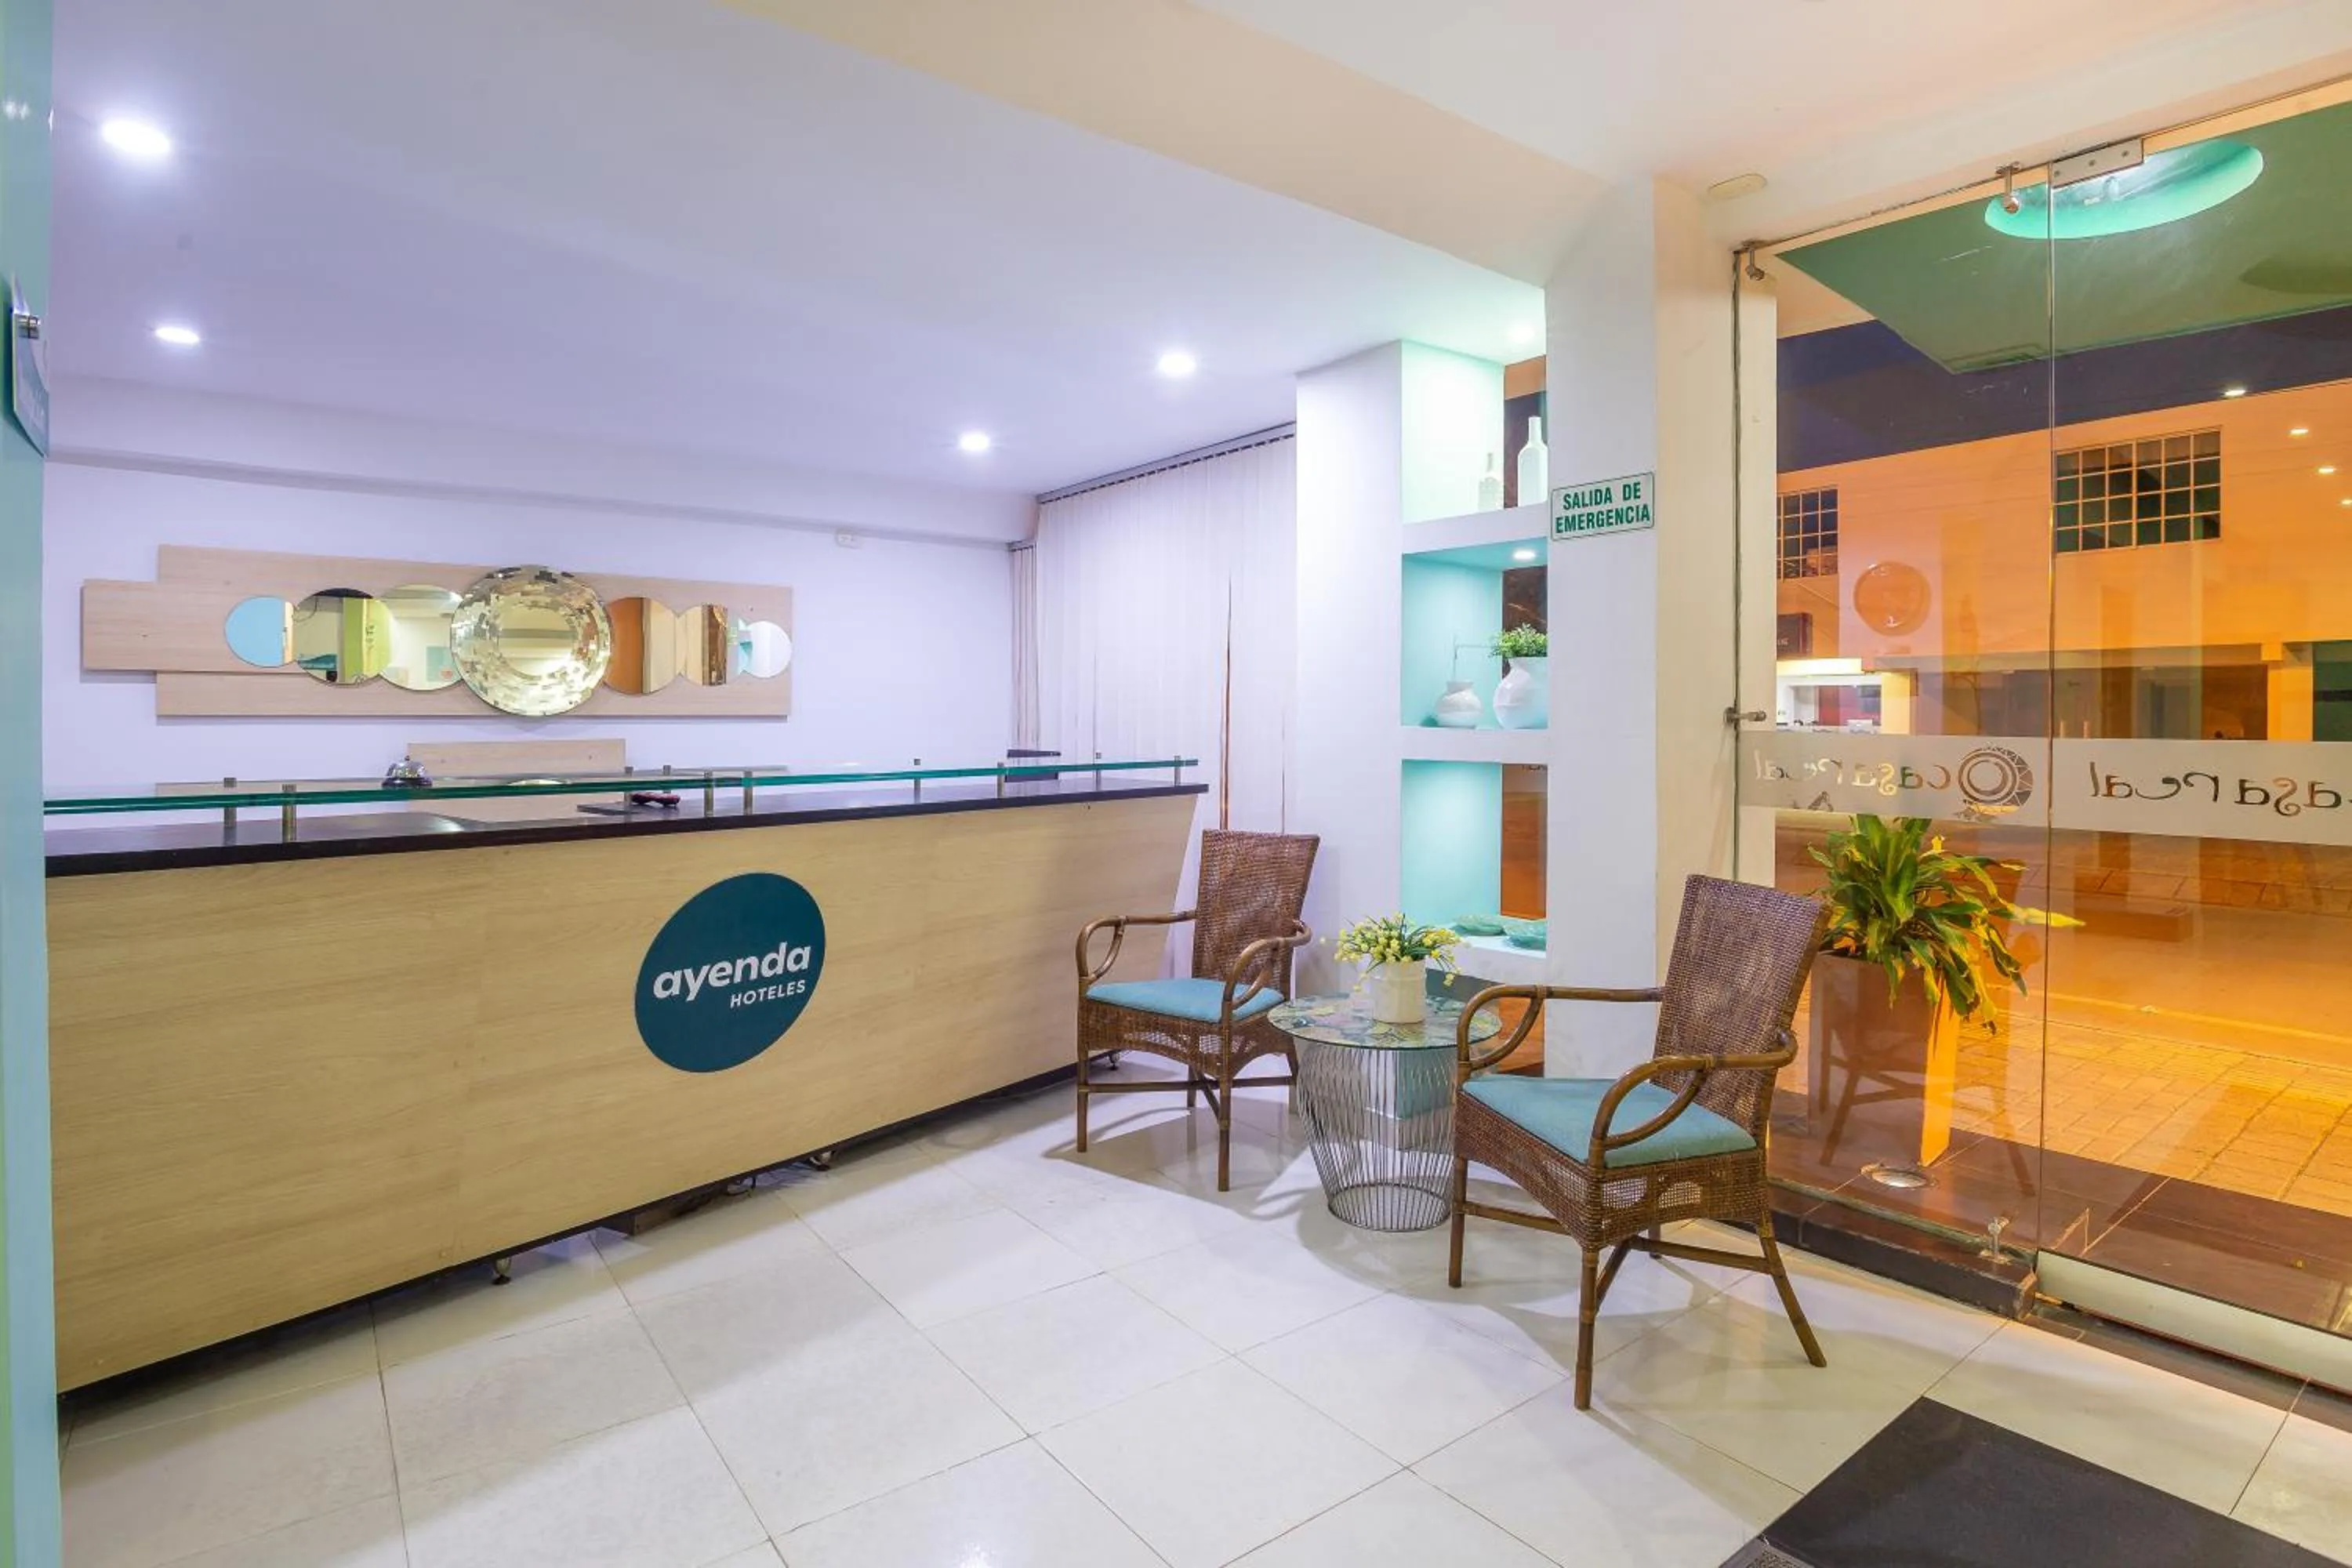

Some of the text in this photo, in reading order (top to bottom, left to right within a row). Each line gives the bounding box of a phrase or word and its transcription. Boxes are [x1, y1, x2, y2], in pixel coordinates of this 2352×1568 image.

[1563, 481, 1641, 510] SALIDA DE
[1555, 503, 1650, 534] EMERGENCIA
[652, 941, 811, 1002] ayenda
[730, 979, 806, 1008] HOTELES
